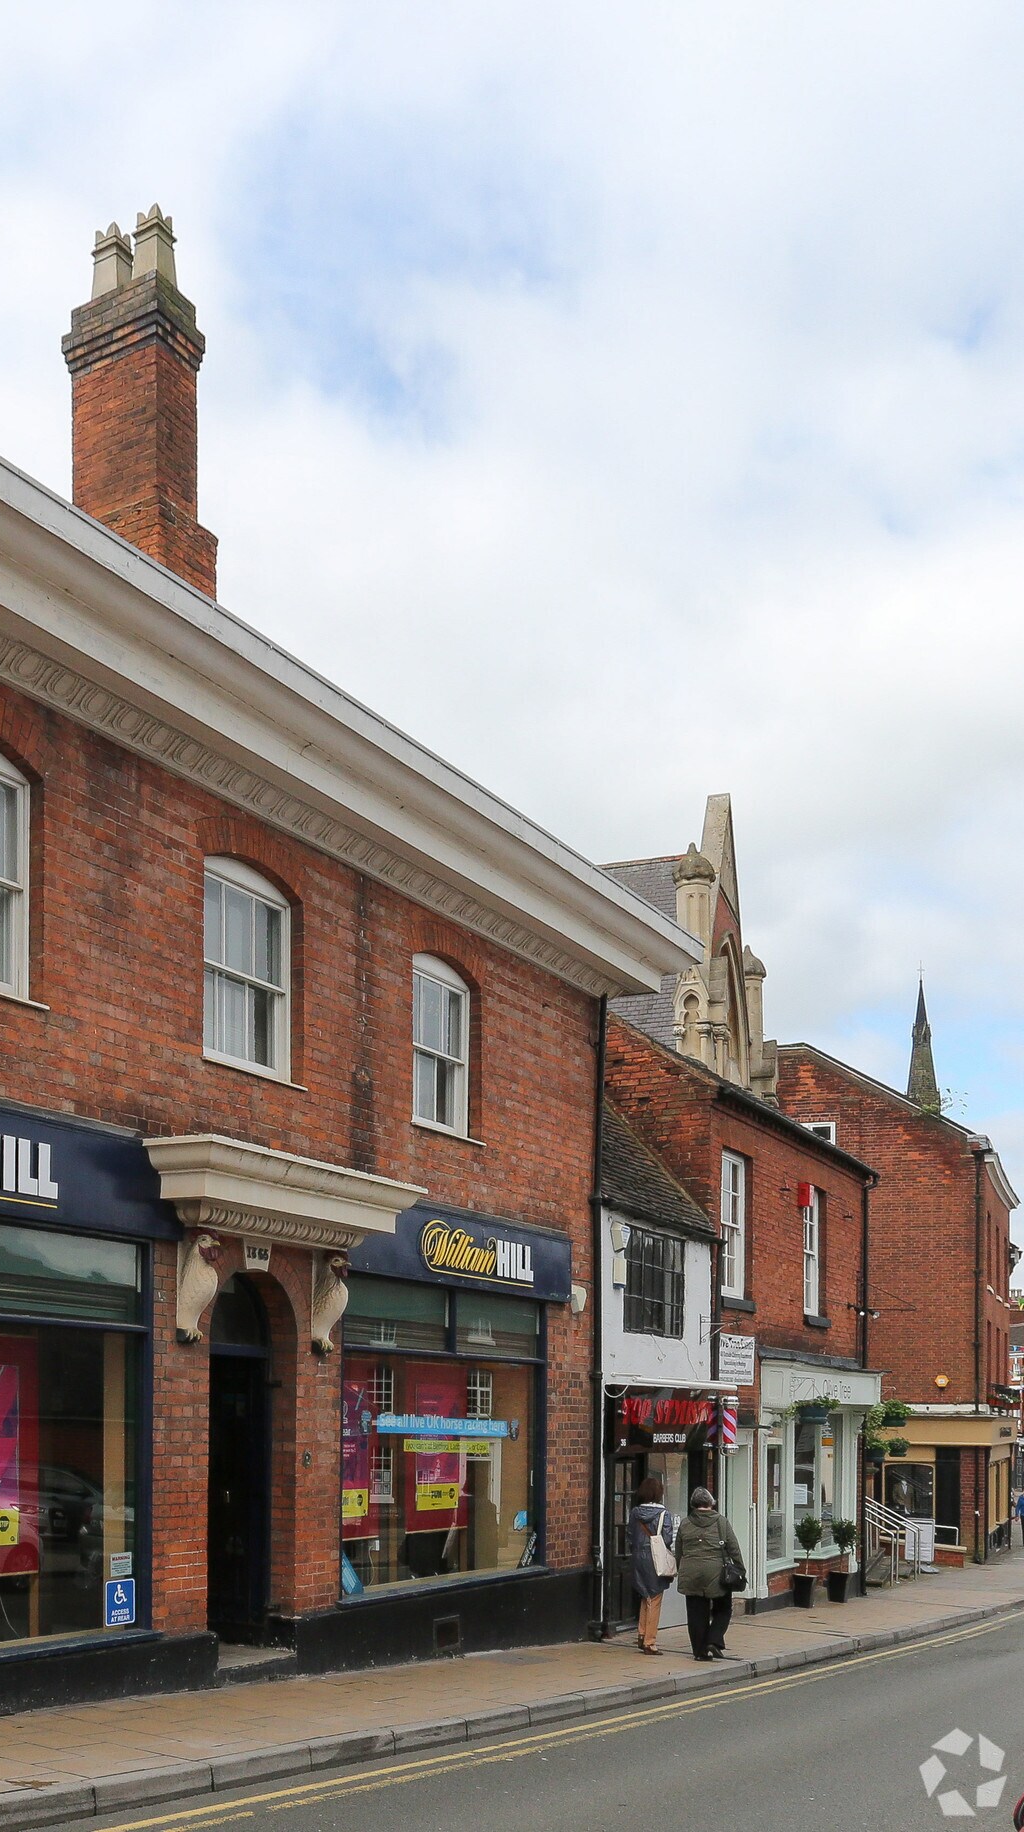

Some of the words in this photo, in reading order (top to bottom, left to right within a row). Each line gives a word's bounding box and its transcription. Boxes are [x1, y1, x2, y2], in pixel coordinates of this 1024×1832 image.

[421, 1220, 496, 1275] William
[497, 1239, 534, 1282] HILL
[410, 1413, 425, 1428] live
[426, 1414, 440, 1429] UK
[440, 1415, 463, 1430] horse
[464, 1417, 487, 1433] racing
[488, 1418, 506, 1431] here
[653, 1433, 674, 1443] BARBERS
[675, 1434, 687, 1443] CLUB
[111, 1608, 129, 1616] ACCESS
